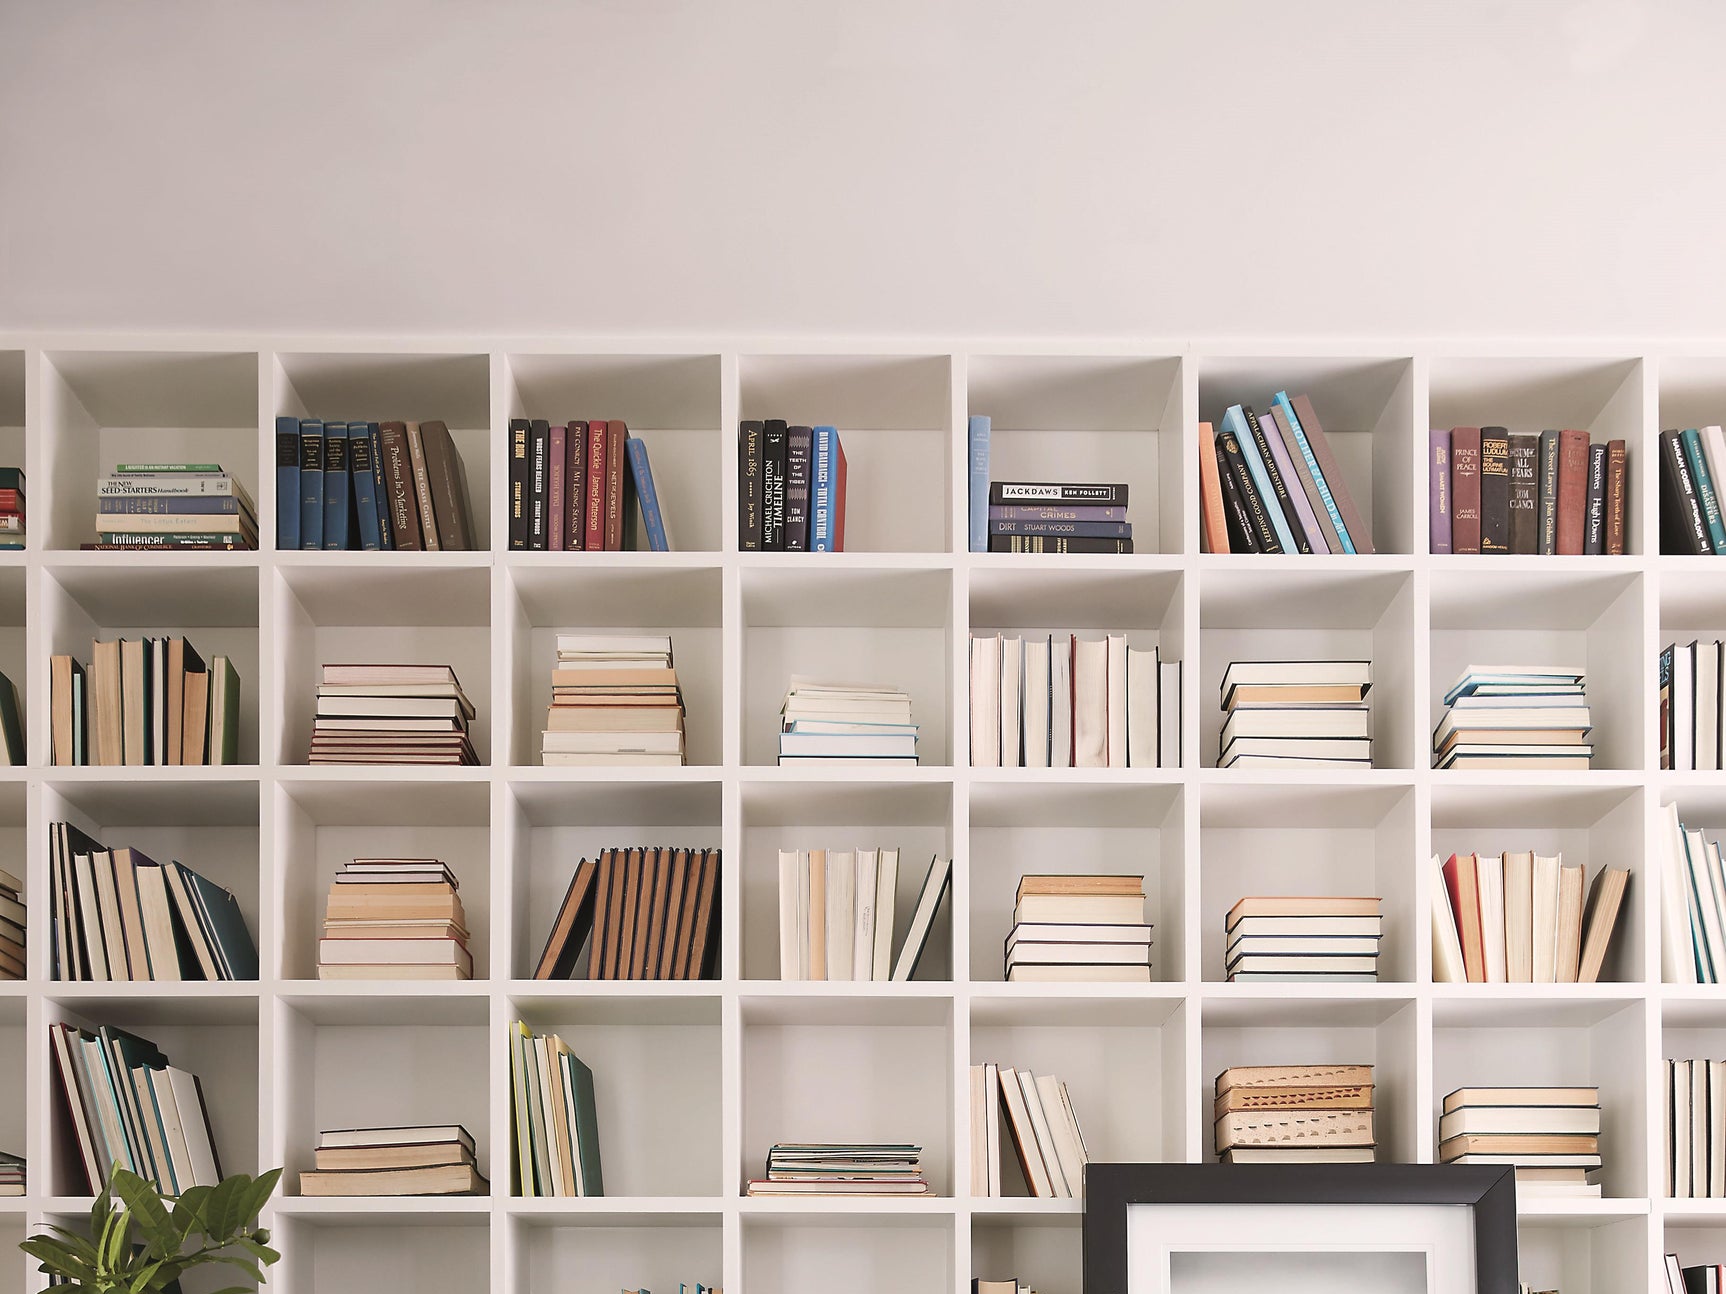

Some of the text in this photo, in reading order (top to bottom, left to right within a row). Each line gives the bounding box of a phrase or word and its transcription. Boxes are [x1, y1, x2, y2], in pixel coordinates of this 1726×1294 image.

[515, 430, 525, 458] THE RUN
[592, 429, 603, 469] The Quickie
[747, 430, 758, 477] APRIL 1865
[818, 432, 828, 482] DAVID BALDACCI
[1248, 411, 1287, 499] APPALACHIAN ADVENTURE
[1516, 459, 1529, 468] ALL
[1291, 421, 1316, 467] MOTHER
[1316, 478, 1334, 512] CHILD
[1333, 520, 1345, 534] Art
[1512, 468, 1533, 478] FEARS
[1546, 472, 1554, 495] Lawyer
[1593, 449, 1604, 490] Perspectives
[1672, 438, 1692, 495] HARLAN COBEN
[391, 446, 401, 479] Problems
[396, 490, 408, 530] Marketing
[591, 475, 601, 531] James Patterson
[774, 476, 783, 528] TIMELINE
[1237, 464, 1272, 543] KEEPING GOOD COMPANY
[1510, 500, 1534, 510] CLANCY
[1516, 489, 1529, 499] TOM
[1701, 484, 1716, 524] DISASTERS
[816, 488, 827, 540] TOTAL CONTROL
[1545, 502, 1554, 516] John
[1591, 498, 1601, 544] Hugh Downs
[1690, 498, 1698, 512] JUST
[1695, 523, 1704, 539] LOOK
[112, 534, 164, 544] Influencer
